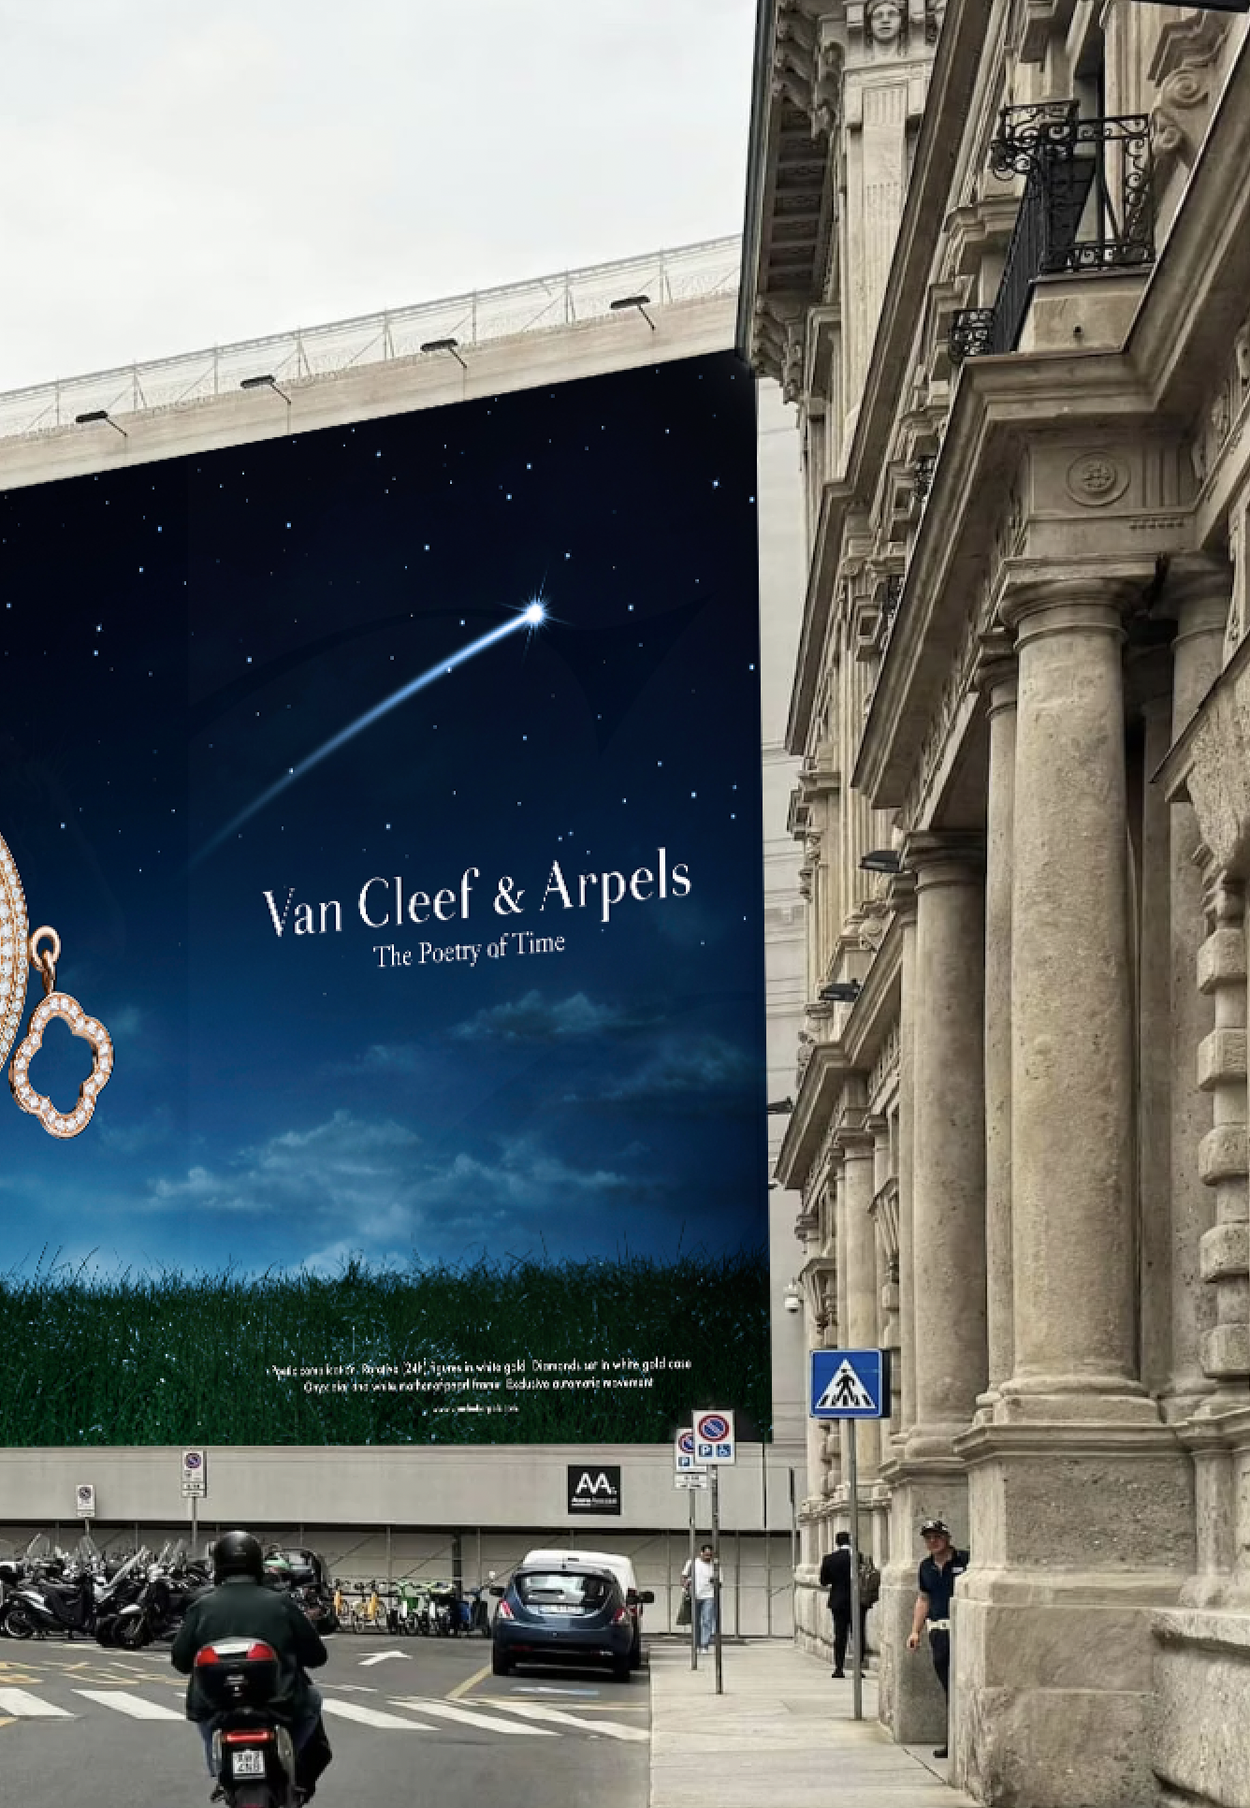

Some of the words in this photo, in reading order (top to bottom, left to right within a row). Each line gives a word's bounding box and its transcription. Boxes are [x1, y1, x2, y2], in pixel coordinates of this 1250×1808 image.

[263, 887, 343, 937] Van
[358, 867, 480, 928] Cleef
[493, 876, 525, 915] &
[539, 847, 692, 922] Arpels
[373, 944, 413, 967] The
[418, 942, 481, 967] Poetry
[487, 933, 508, 958] of
[512, 931, 566, 954] Time
[475, 1359, 502, 1373] white
[601, 1358, 610, 1371] in
[613, 1357, 640, 1371] white
[642, 1355, 666, 1374] gold
